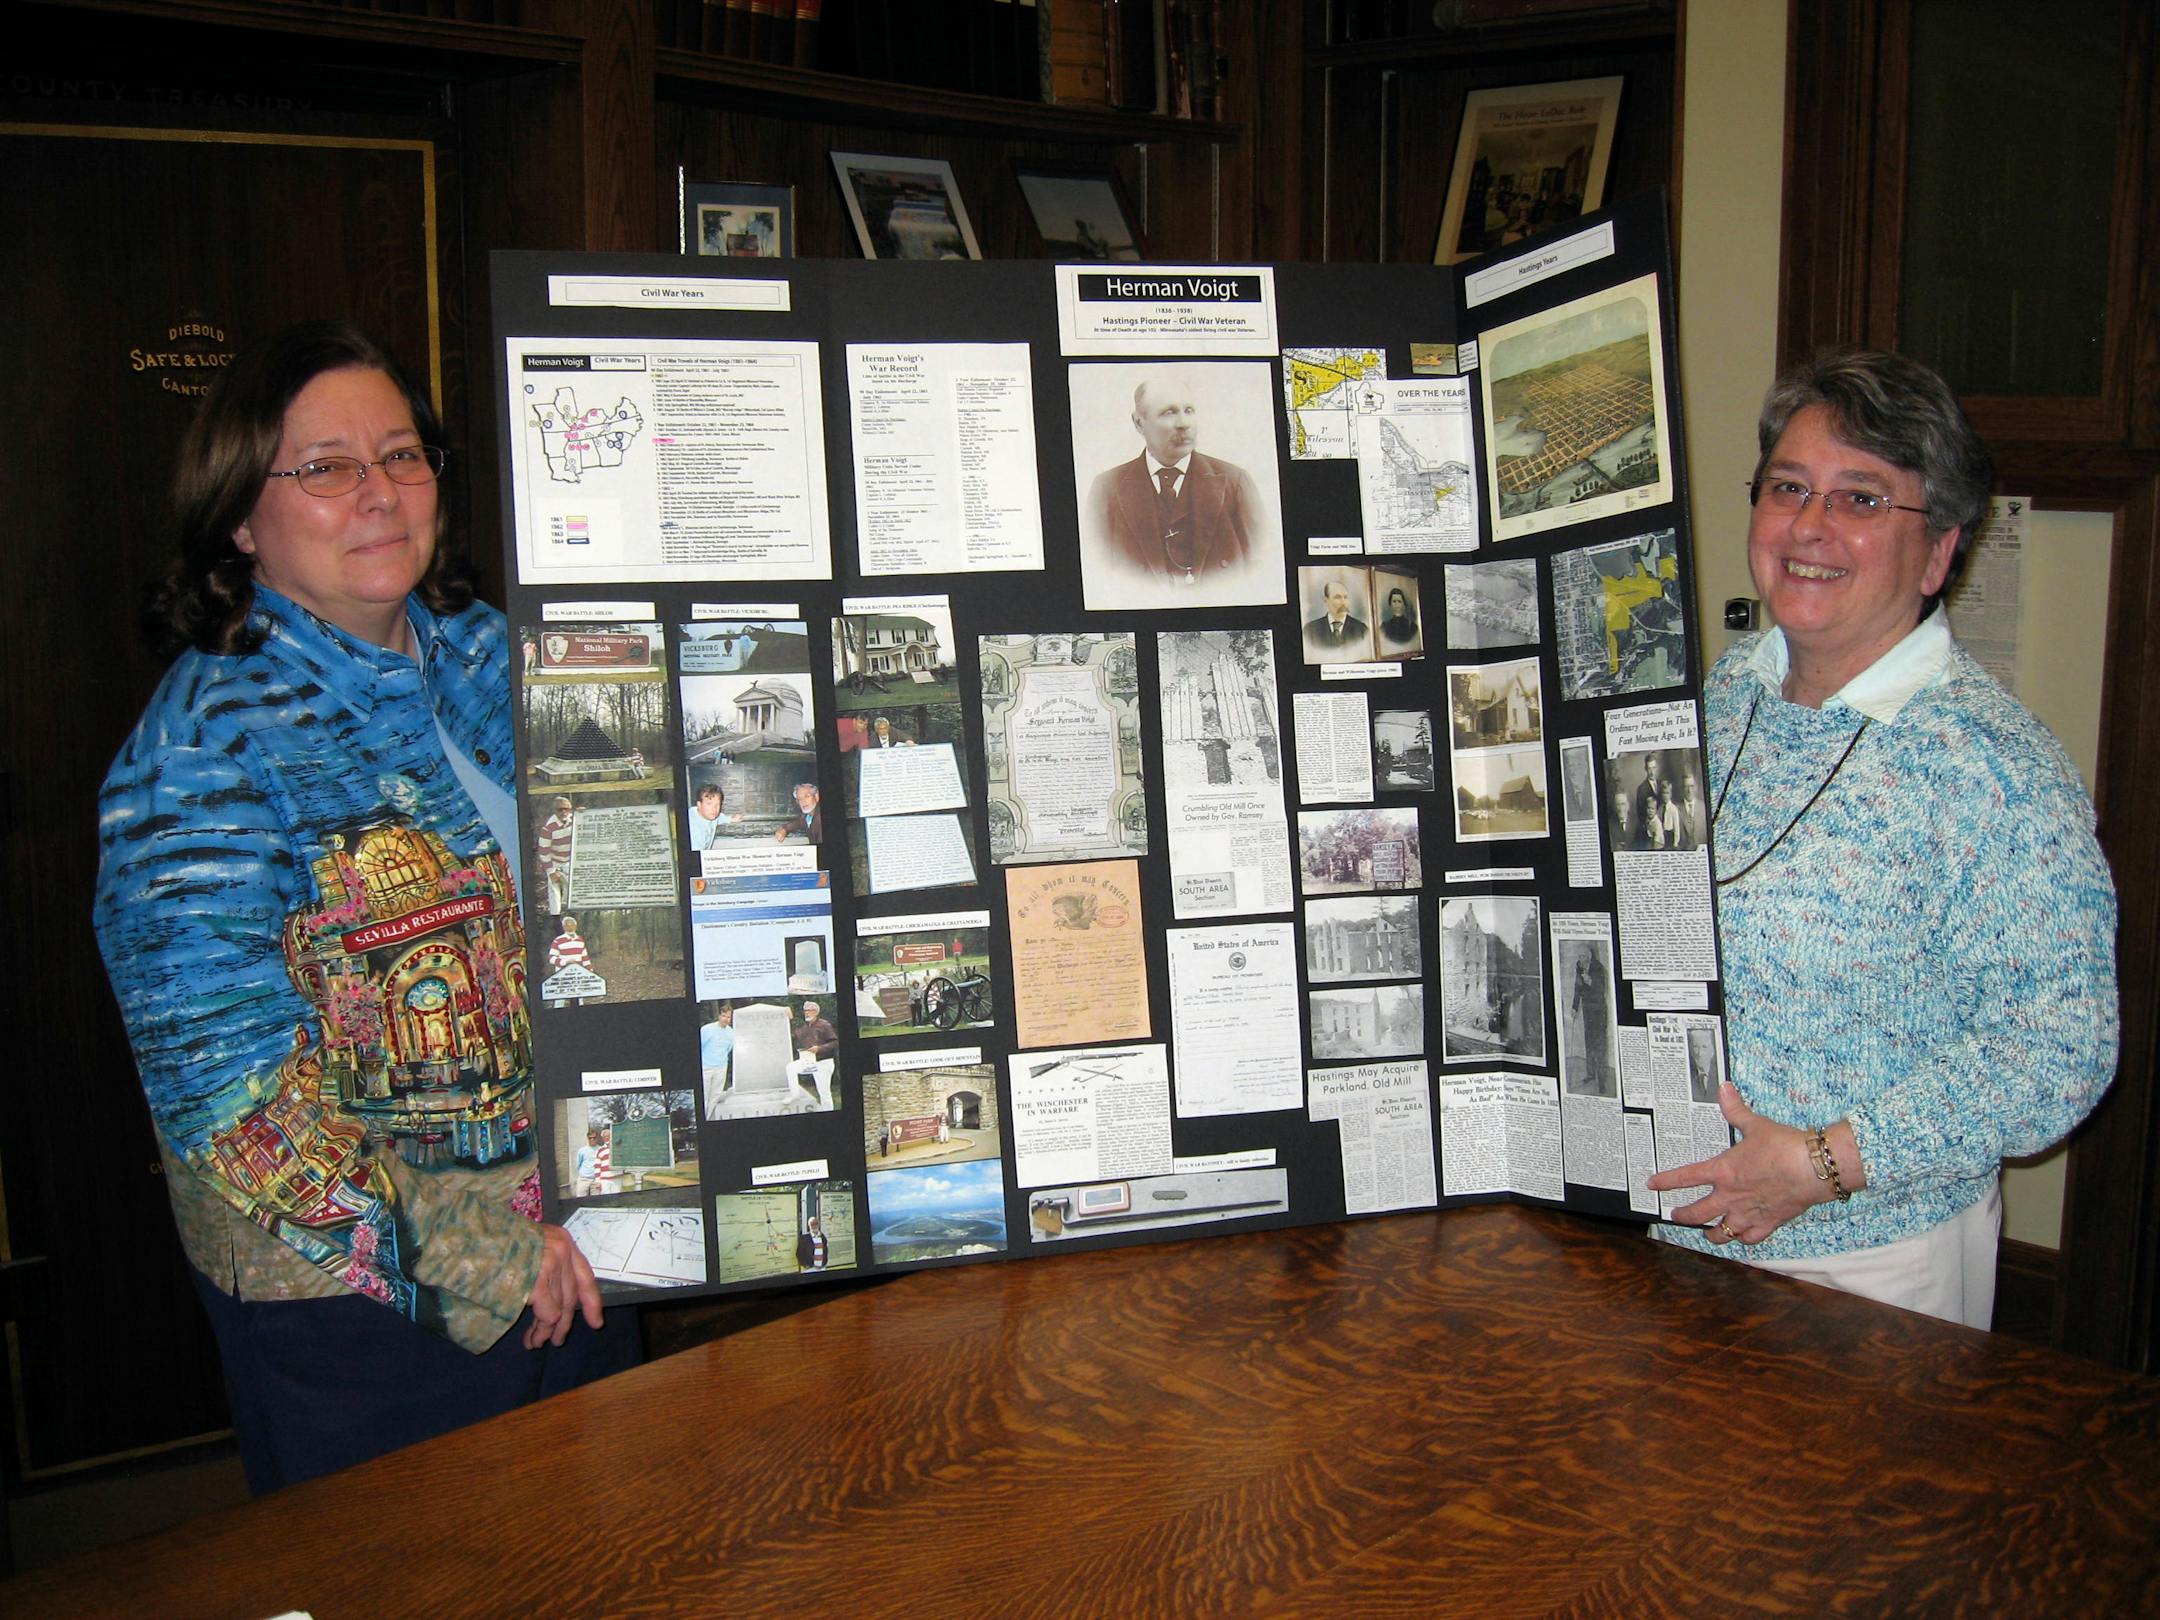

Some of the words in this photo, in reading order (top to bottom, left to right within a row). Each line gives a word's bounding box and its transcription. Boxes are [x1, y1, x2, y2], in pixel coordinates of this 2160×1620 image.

[0, 72, 128, 104] OUNTY
[1518, 261, 1543, 276] Hastings
[1542, 254, 1558, 268] Years
[641, 288, 660, 298] Civil
[662, 289, 680, 298] War
[680, 289, 704, 298] Years
[1106, 278, 1184, 297] Herman
[1186, 278, 1238, 301] Voigt
[1103, 317, 1138, 326] Hastings
[1140, 317, 1171, 325] Pioneer
[1179, 317, 1196, 325] Civil
[1198, 317, 1214, 325] War
[1214, 317, 1246, 325] Veteran
[169, 324, 224, 342] DIEBOLD
[130, 348, 181, 371] SAFE
[184, 354, 197, 367] &
[527, 358, 561, 366] Herman
[562, 358, 584, 368] Voigt
[862, 355, 894, 363] Herman
[897, 354, 924, 363] Voigt's
[162, 377, 209, 396] CANTO
[1397, 390, 1420, 398] OVER
[1442, 389, 1466, 397] YEARS
[684, 644, 718, 652] VICKSBURG
[1605, 711, 1621, 720] Four
[1683, 702, 1694, 710] An
[1609, 723, 1639, 734] Ordinary
[1641, 720, 1665, 730] Picture
[1666, 717, 1673, 725] In
[1675, 715, 1690, 725] This
[1618, 736, 1633, 746] Fast
[1635, 733, 1659, 744] Moving
[1679, 729, 1686, 738] Is
[1687, 727, 1696, 737] It?
[1183, 804, 1218, 812] Crumbling
[1211, 813, 1219, 821] by
[1238, 812, 1263, 820] Ramsey
[1179, 887, 1205, 895] SOUTH
[355, 923, 410, 945] SEVILLA
[412, 900, 485, 928] RESTAURANTE
[1313, 1072, 1354, 1082] Hastings
[1358, 1068, 1378, 1077] May
[1383, 1064, 1419, 1075] Acquire
[1373, 1079, 1390, 1088] Old
[1394, 1076, 1411, 1086] Mill
[1036, 1098, 1089, 1108] WINCHESTER
[1375, 1106, 1400, 1115] SOUTH
[1403, 1103, 1423, 1111] AREA
[1040, 1106, 1078, 1116] WARFARE
